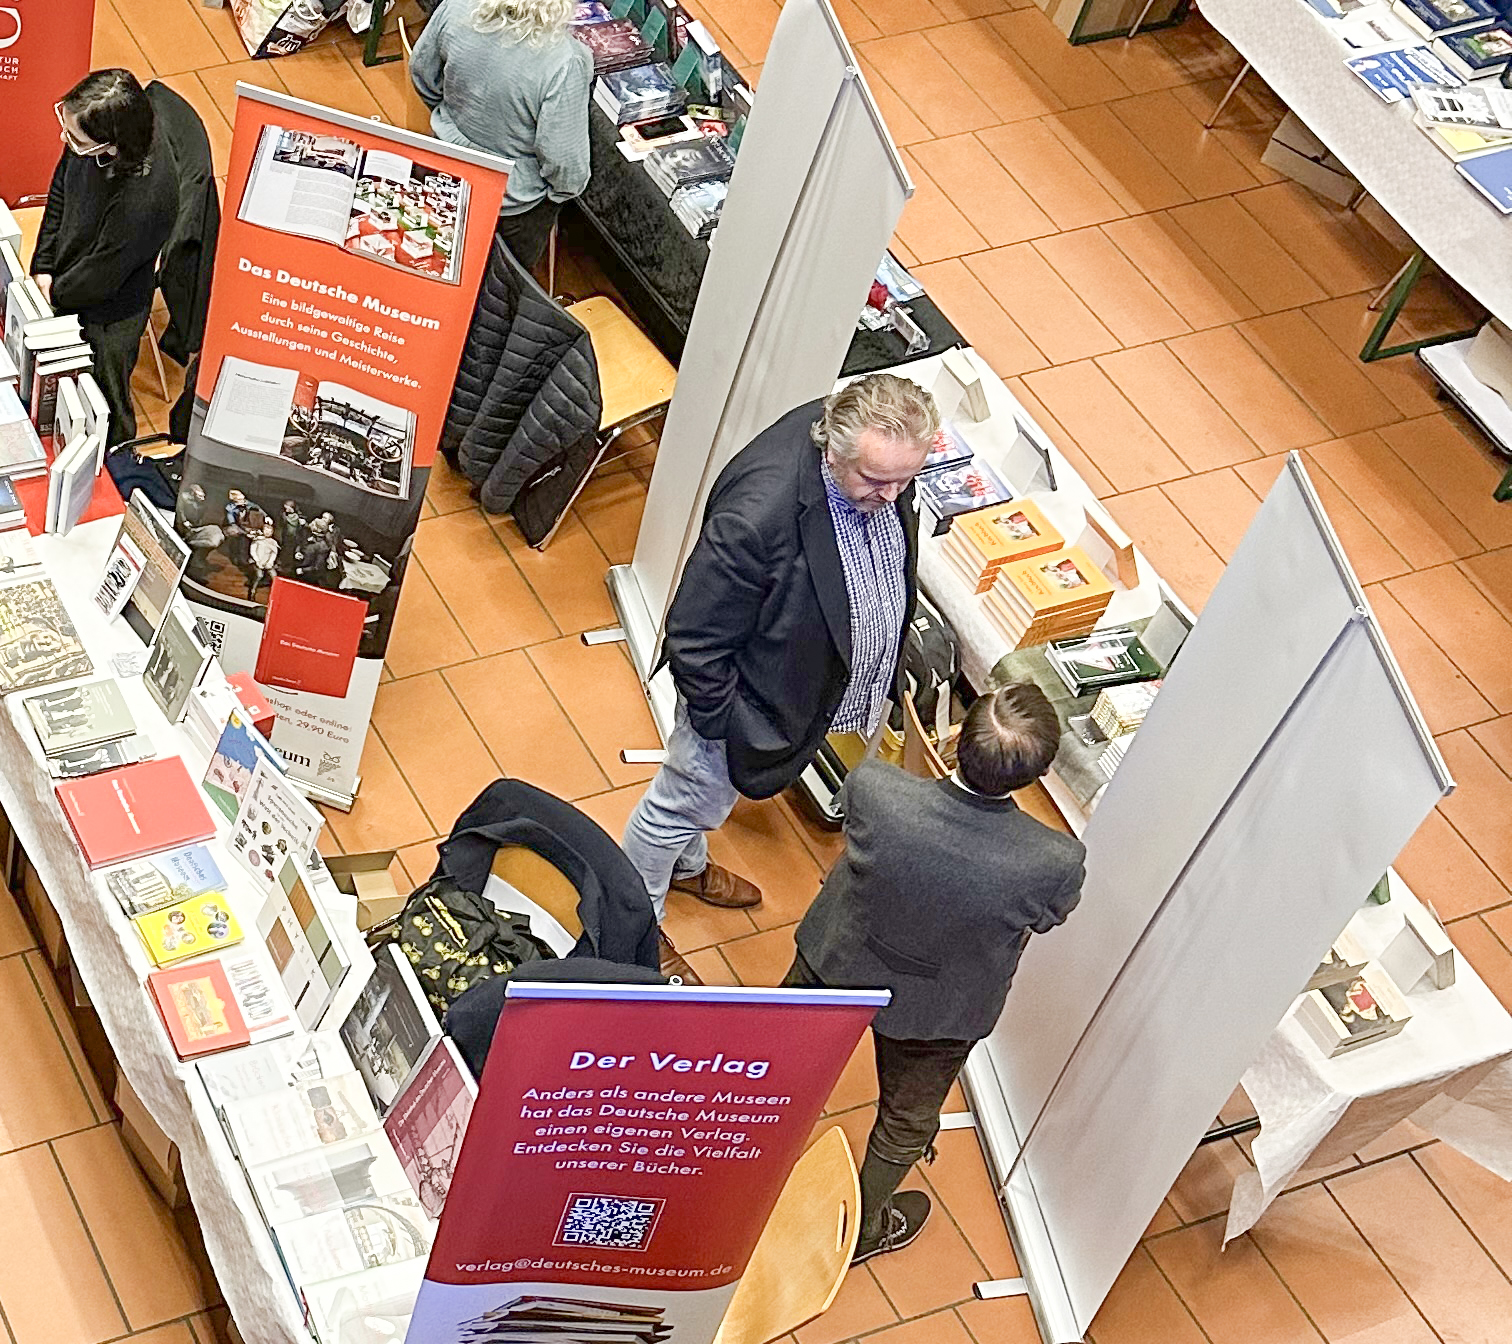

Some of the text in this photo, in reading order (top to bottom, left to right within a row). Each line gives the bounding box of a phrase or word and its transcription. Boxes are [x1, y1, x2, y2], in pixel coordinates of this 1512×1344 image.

[238, 257, 440, 330] Das Deutsche Museum
[261, 291, 406, 346] Eine bildgewaltige Reise
[260, 311, 399, 364] durch seine Geschichte,
[230, 321, 422, 390] Ausstellungen und Meisterwerke.
[294, 707, 318, 721] oder
[326, 728, 350, 745] Euro
[275, 746, 311, 768] eum
[569, 1051, 770, 1079] Der Verlag
[522, 1085, 792, 1106] Anders als andere Museen
[519, 1104, 780, 1124] hat das Deutsche Museum
[535, 1123, 751, 1144] einen eigenen Verlag.
[513, 1139, 763, 1160] Entdecken Sie die Vielfalt
[554, 1159, 704, 1176] unserer Bücher.
[454, 1256, 734, 1279] verlag@deutsches-museum.de
